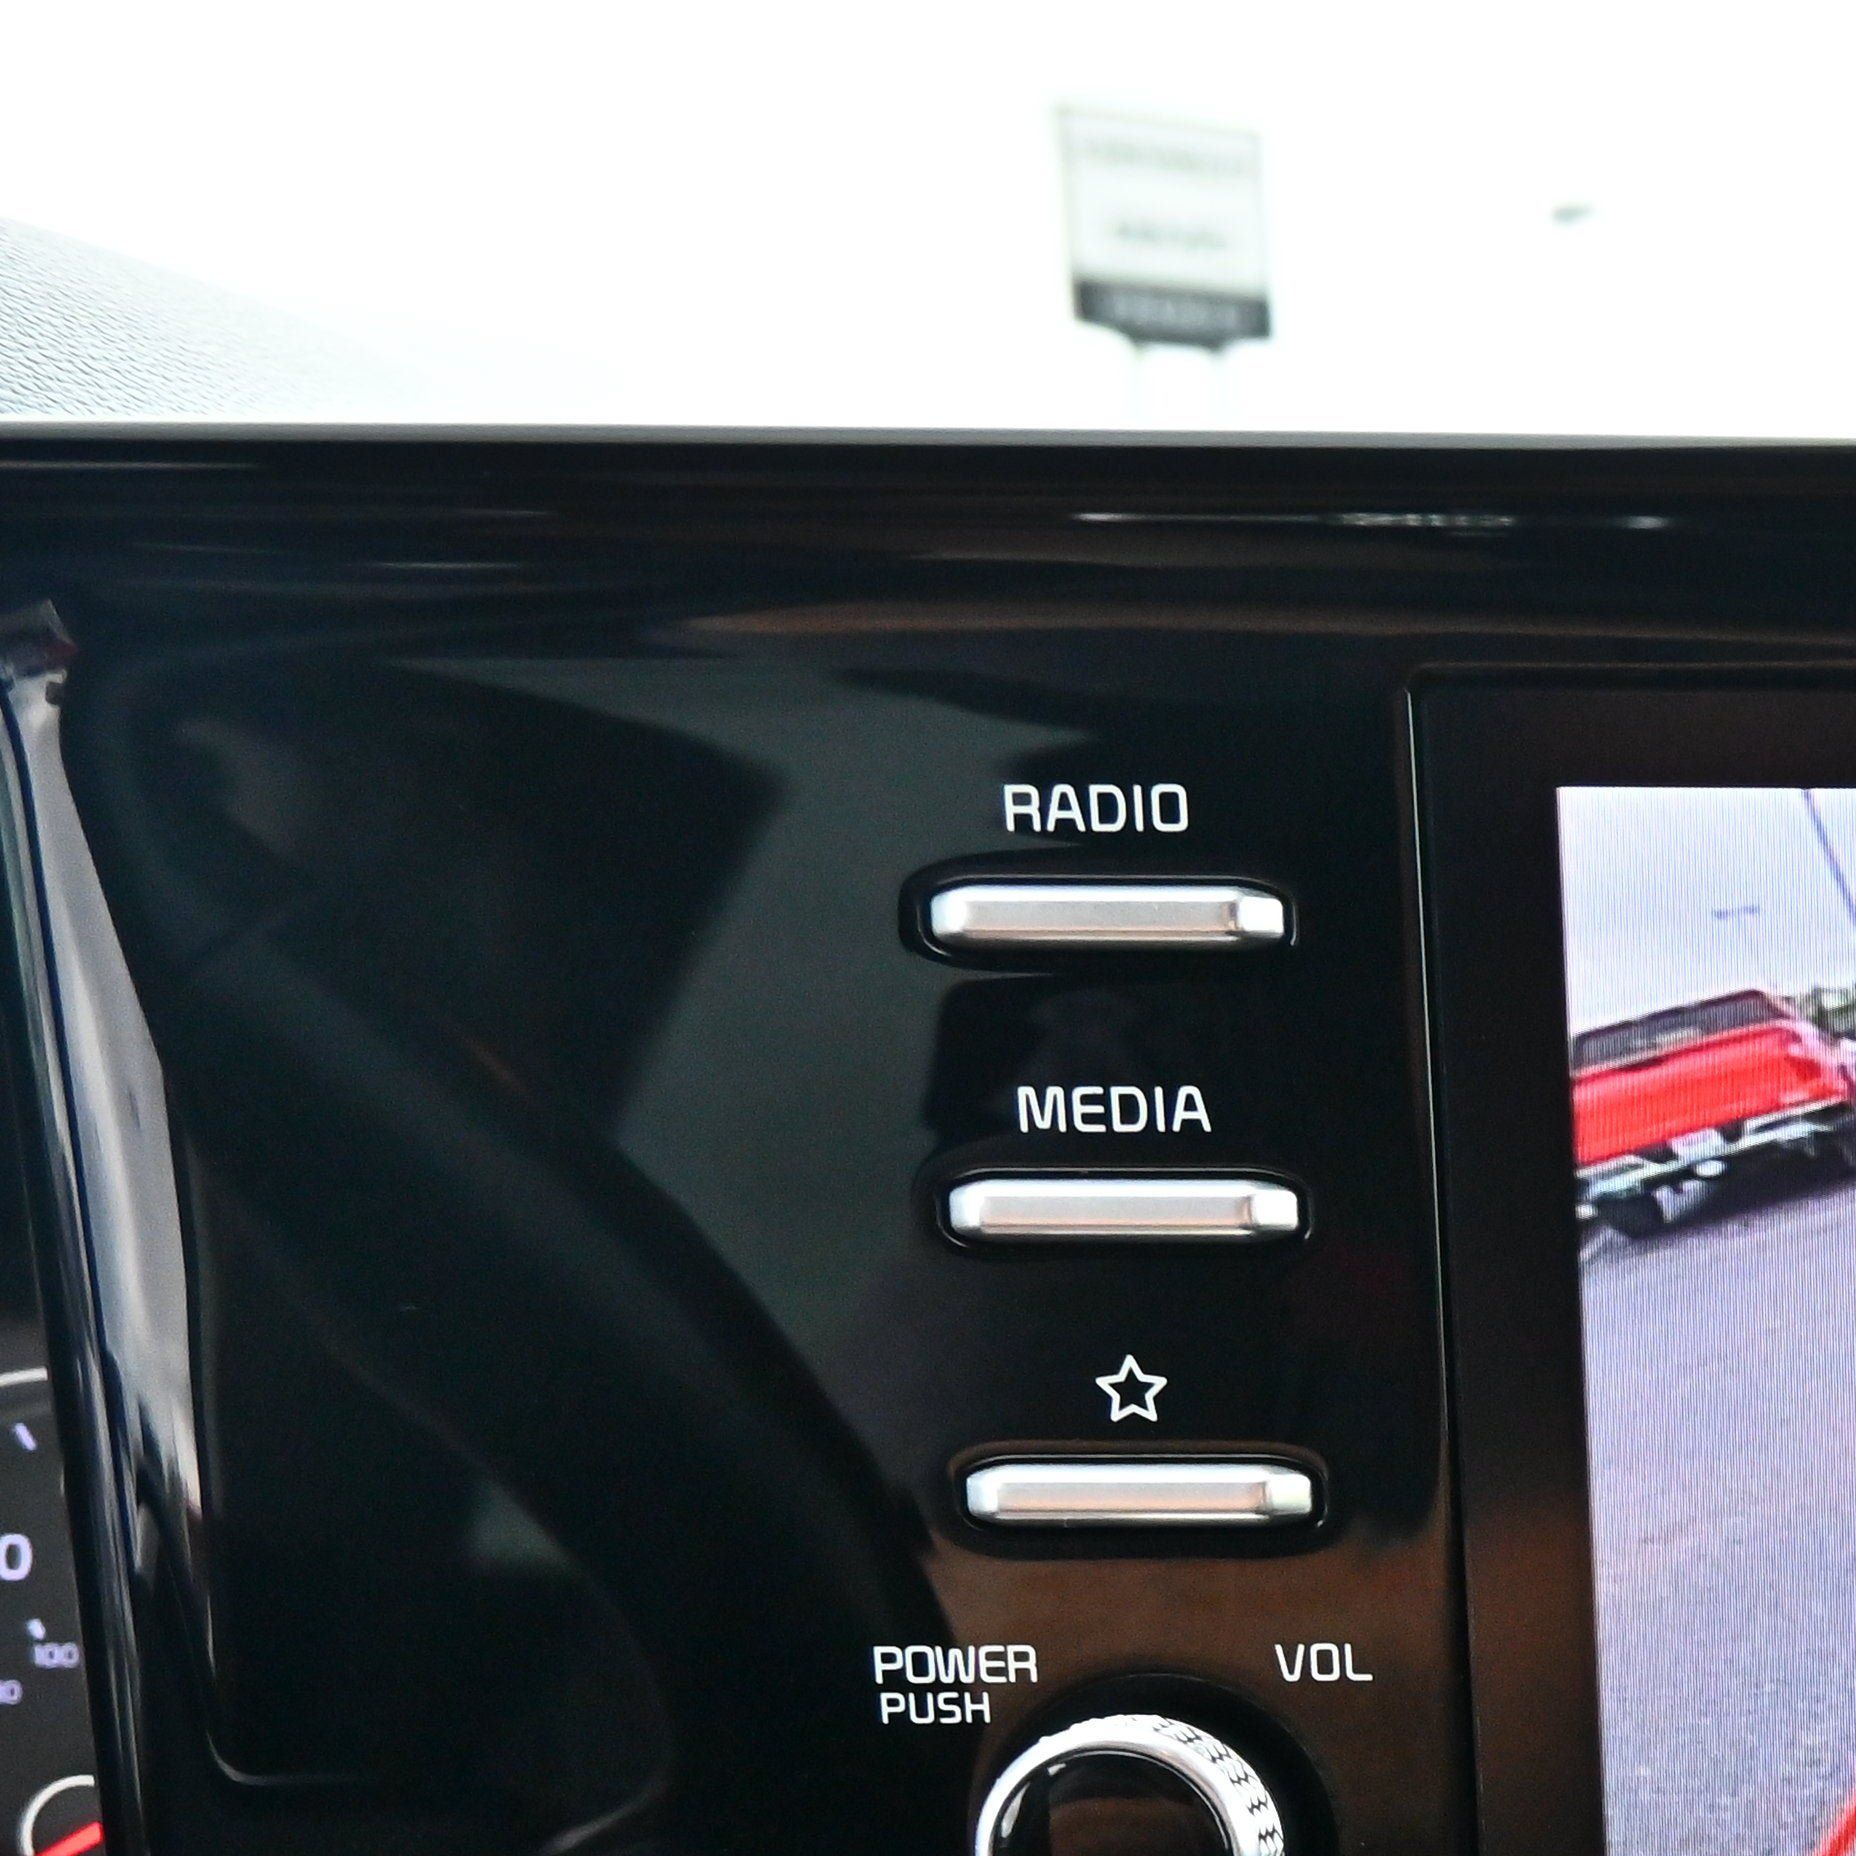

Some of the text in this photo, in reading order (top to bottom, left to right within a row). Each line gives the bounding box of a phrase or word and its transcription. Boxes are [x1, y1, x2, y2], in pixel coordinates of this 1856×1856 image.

[1003, 784, 1188, 832] RADIO
[1017, 1085, 1212, 1133] MEDIA
[873, 1644, 1039, 1685] POWER
[1275, 1643, 1373, 1682] VOL
[880, 1691, 991, 1725] PUSH
